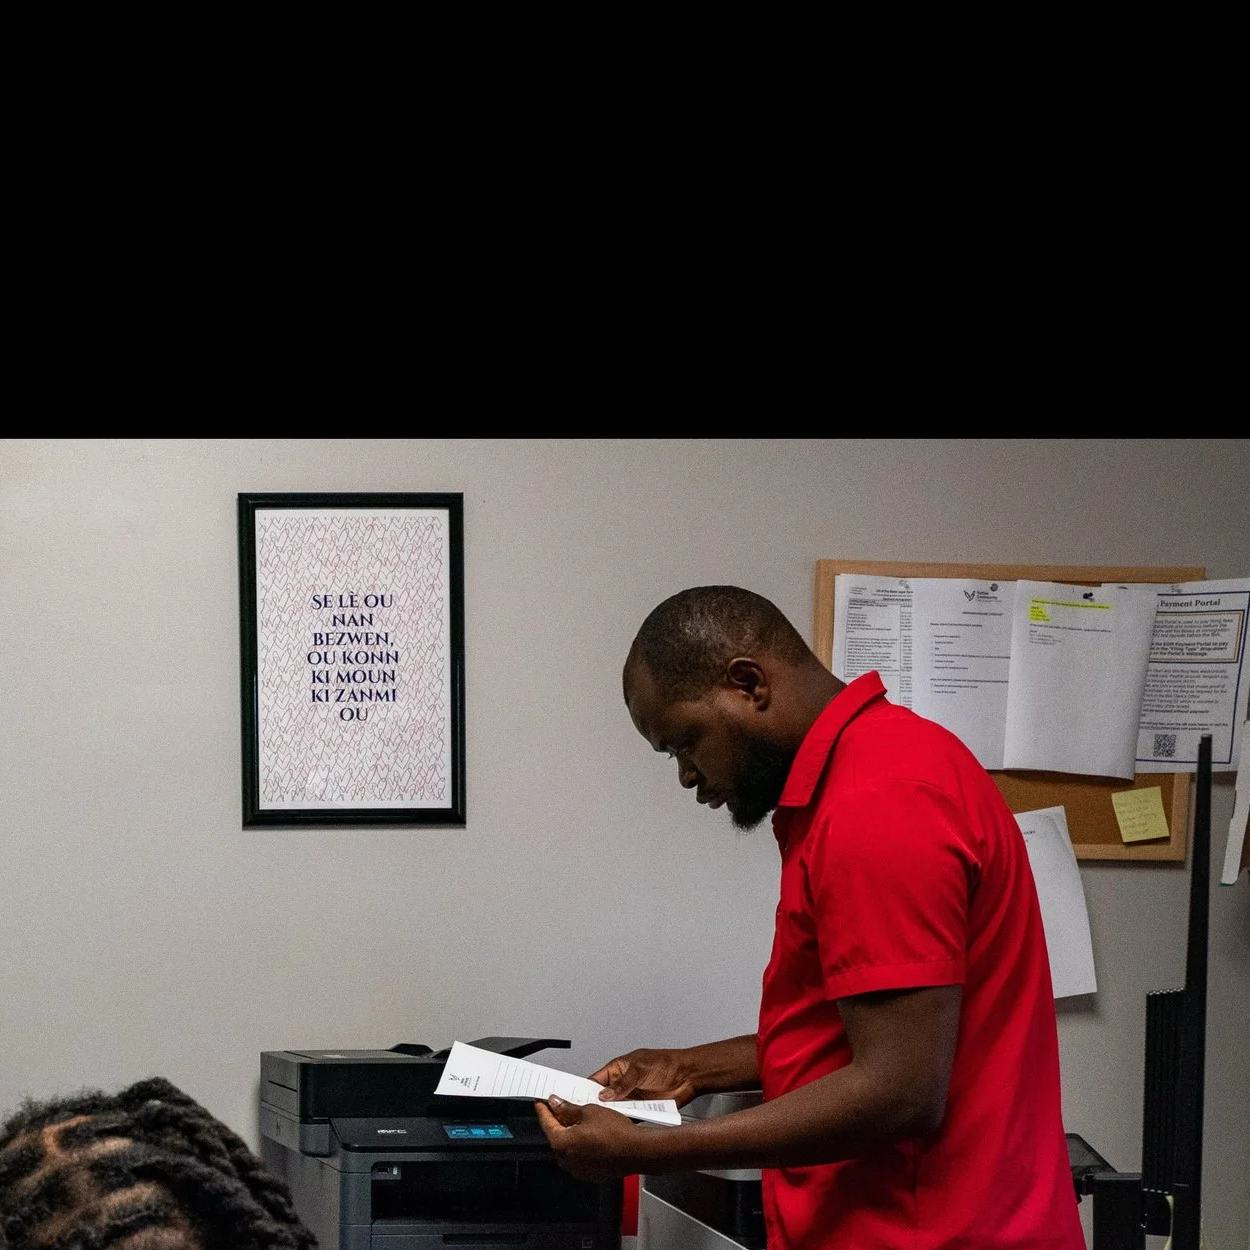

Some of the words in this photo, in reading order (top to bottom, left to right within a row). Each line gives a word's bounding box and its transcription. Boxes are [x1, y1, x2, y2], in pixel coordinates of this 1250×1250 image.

[312, 594, 333, 609] SE
[339, 591, 358, 608] LÈ
[364, 594, 393, 609] OU
[1160, 600, 1192, 608] Payment
[1194, 598, 1221, 607] Portal
[332, 613, 373, 627] NAN
[313, 632, 394, 647] BEZWEN,
[307, 650, 336, 665] OU
[342, 650, 399, 665] KONN
[312, 670, 330, 684] KI
[336, 670, 396, 684] MOUN
[312, 689, 330, 702] KI
[335, 688, 396, 702] ZANMI
[340, 707, 368, 722] OU
